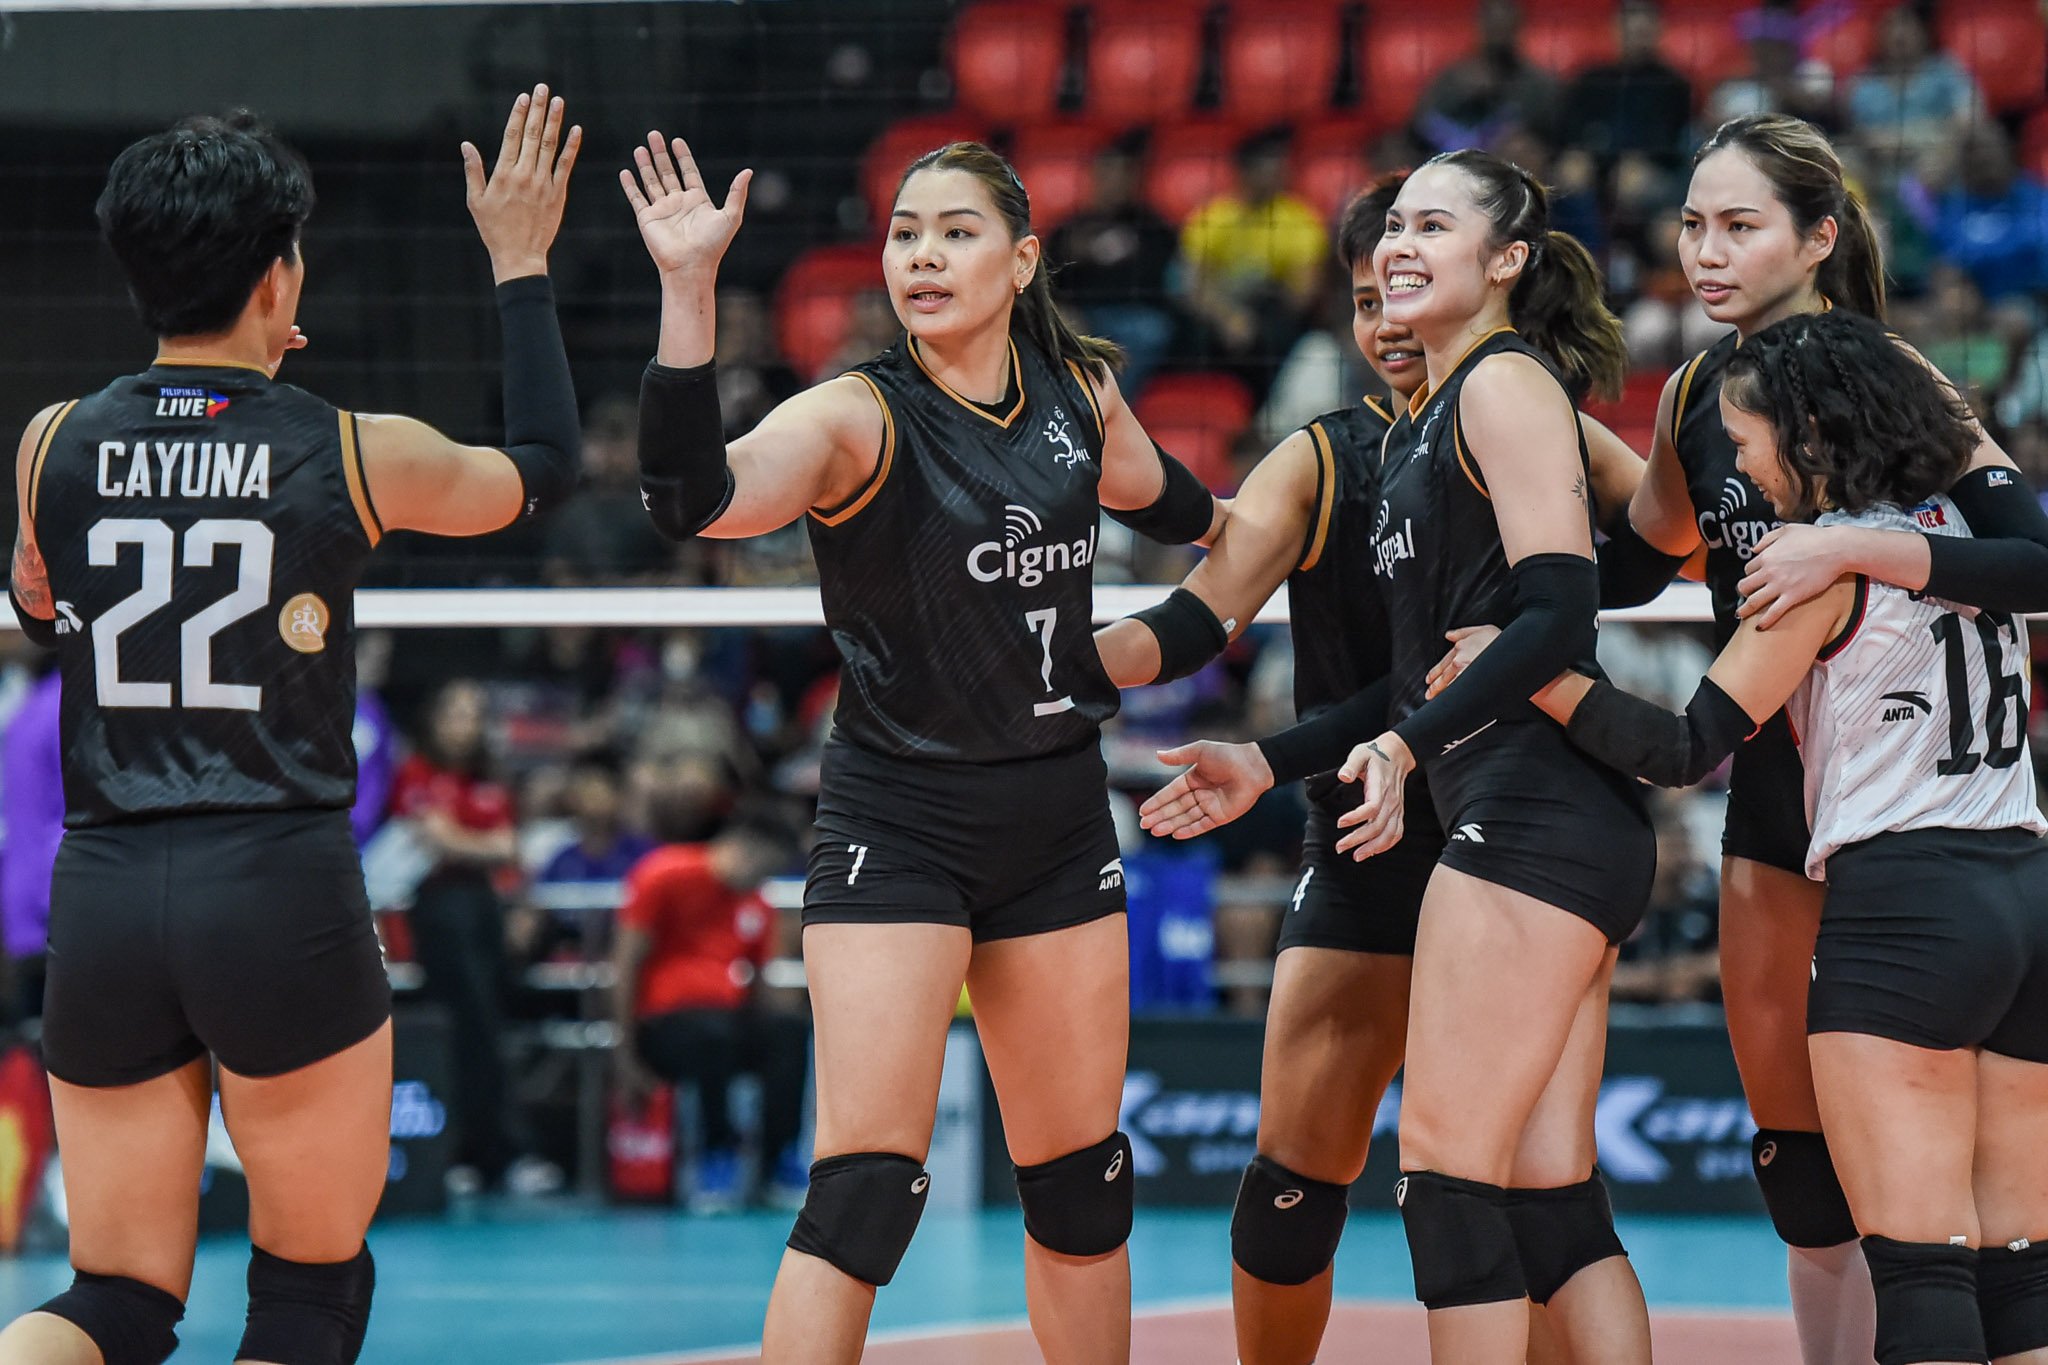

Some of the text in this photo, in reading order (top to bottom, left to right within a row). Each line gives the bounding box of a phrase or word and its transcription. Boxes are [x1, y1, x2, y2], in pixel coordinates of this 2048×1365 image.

[155, 398, 206, 416] LIVE
[160, 387, 202, 397] PILIPINAS
[97, 441, 270, 499] CAYUNA
[966, 525, 1095, 587] Cignal
[1698, 510, 1786, 560] Cign
[87, 518, 275, 712] 22
[1024, 607, 1057, 692] 7
[1881, 705, 1914, 722] ANTA
[1929, 611, 2029, 777] 16
[847, 843, 869, 885] 7
[1098, 872, 1121, 890] ANTA
[1292, 866, 1315, 912] 4
